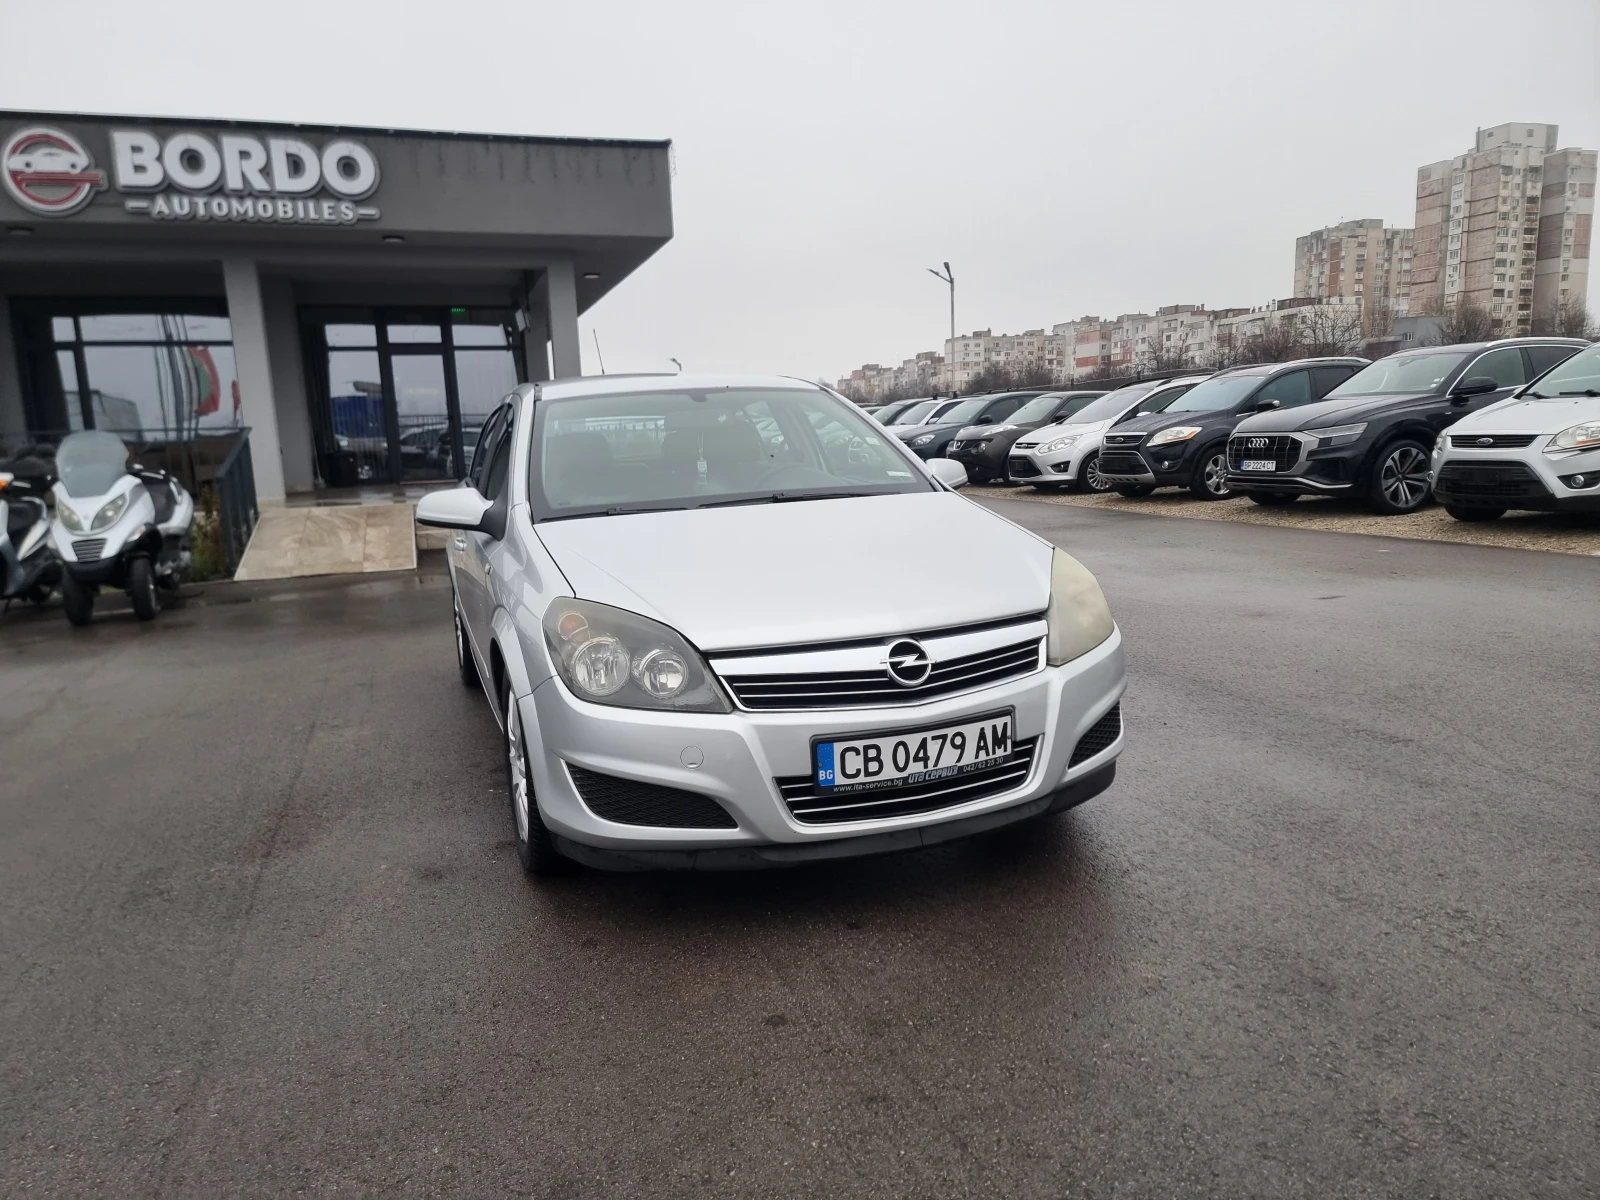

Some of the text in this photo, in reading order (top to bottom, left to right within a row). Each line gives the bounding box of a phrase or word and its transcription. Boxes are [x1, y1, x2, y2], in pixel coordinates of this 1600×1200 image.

[111, 131, 377, 196] BORDO
[153, 196, 355, 221] AUTOMOBILES
[840, 722, 1008, 780] CB 0479 AM
[818, 770, 834, 780] BG
[833, 778, 903, 793] www.ita-service.bg
